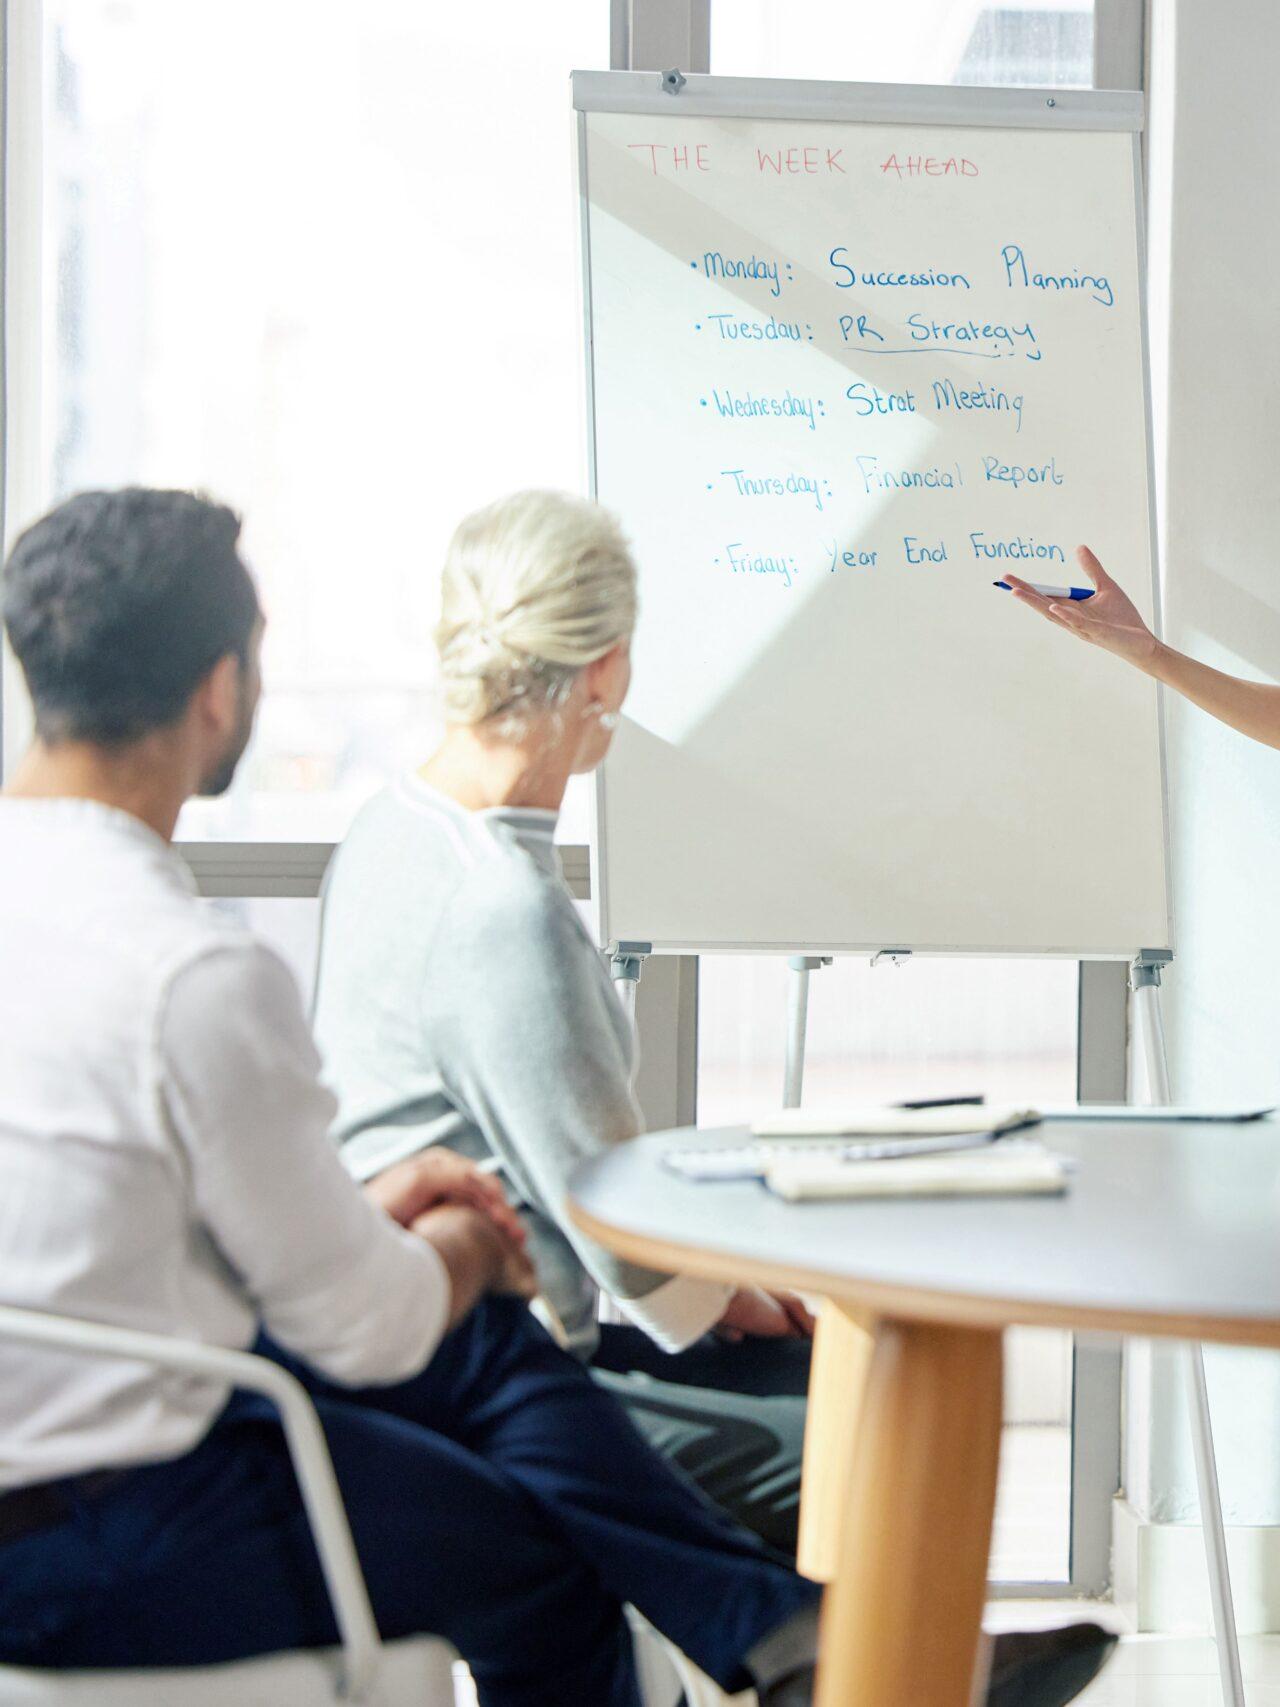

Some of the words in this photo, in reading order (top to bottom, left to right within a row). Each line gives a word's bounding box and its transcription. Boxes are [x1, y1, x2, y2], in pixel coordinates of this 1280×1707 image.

[627, 143, 711, 176] THE
[756, 147, 847, 176] WEEK
[879, 154, 980, 178] AHEAD
[703, 252, 794, 297] Monday:
[829, 247, 970, 289] Succession
[1001, 245, 1114, 306] Planning
[840, 316, 885, 342] PR
[906, 313, 1042, 361] Strategy
[713, 390, 826, 431] Wednesday:
[846, 383, 916, 417] Strat
[932, 378, 1025, 433] Meeting
[856, 456, 963, 494] Financial
[982, 456, 1064, 486] Report
[726, 543, 799, 588] Friday:
[821, 538, 879, 574] Year
[904, 536, 948, 565] End
[969, 532, 1066, 563] Function
